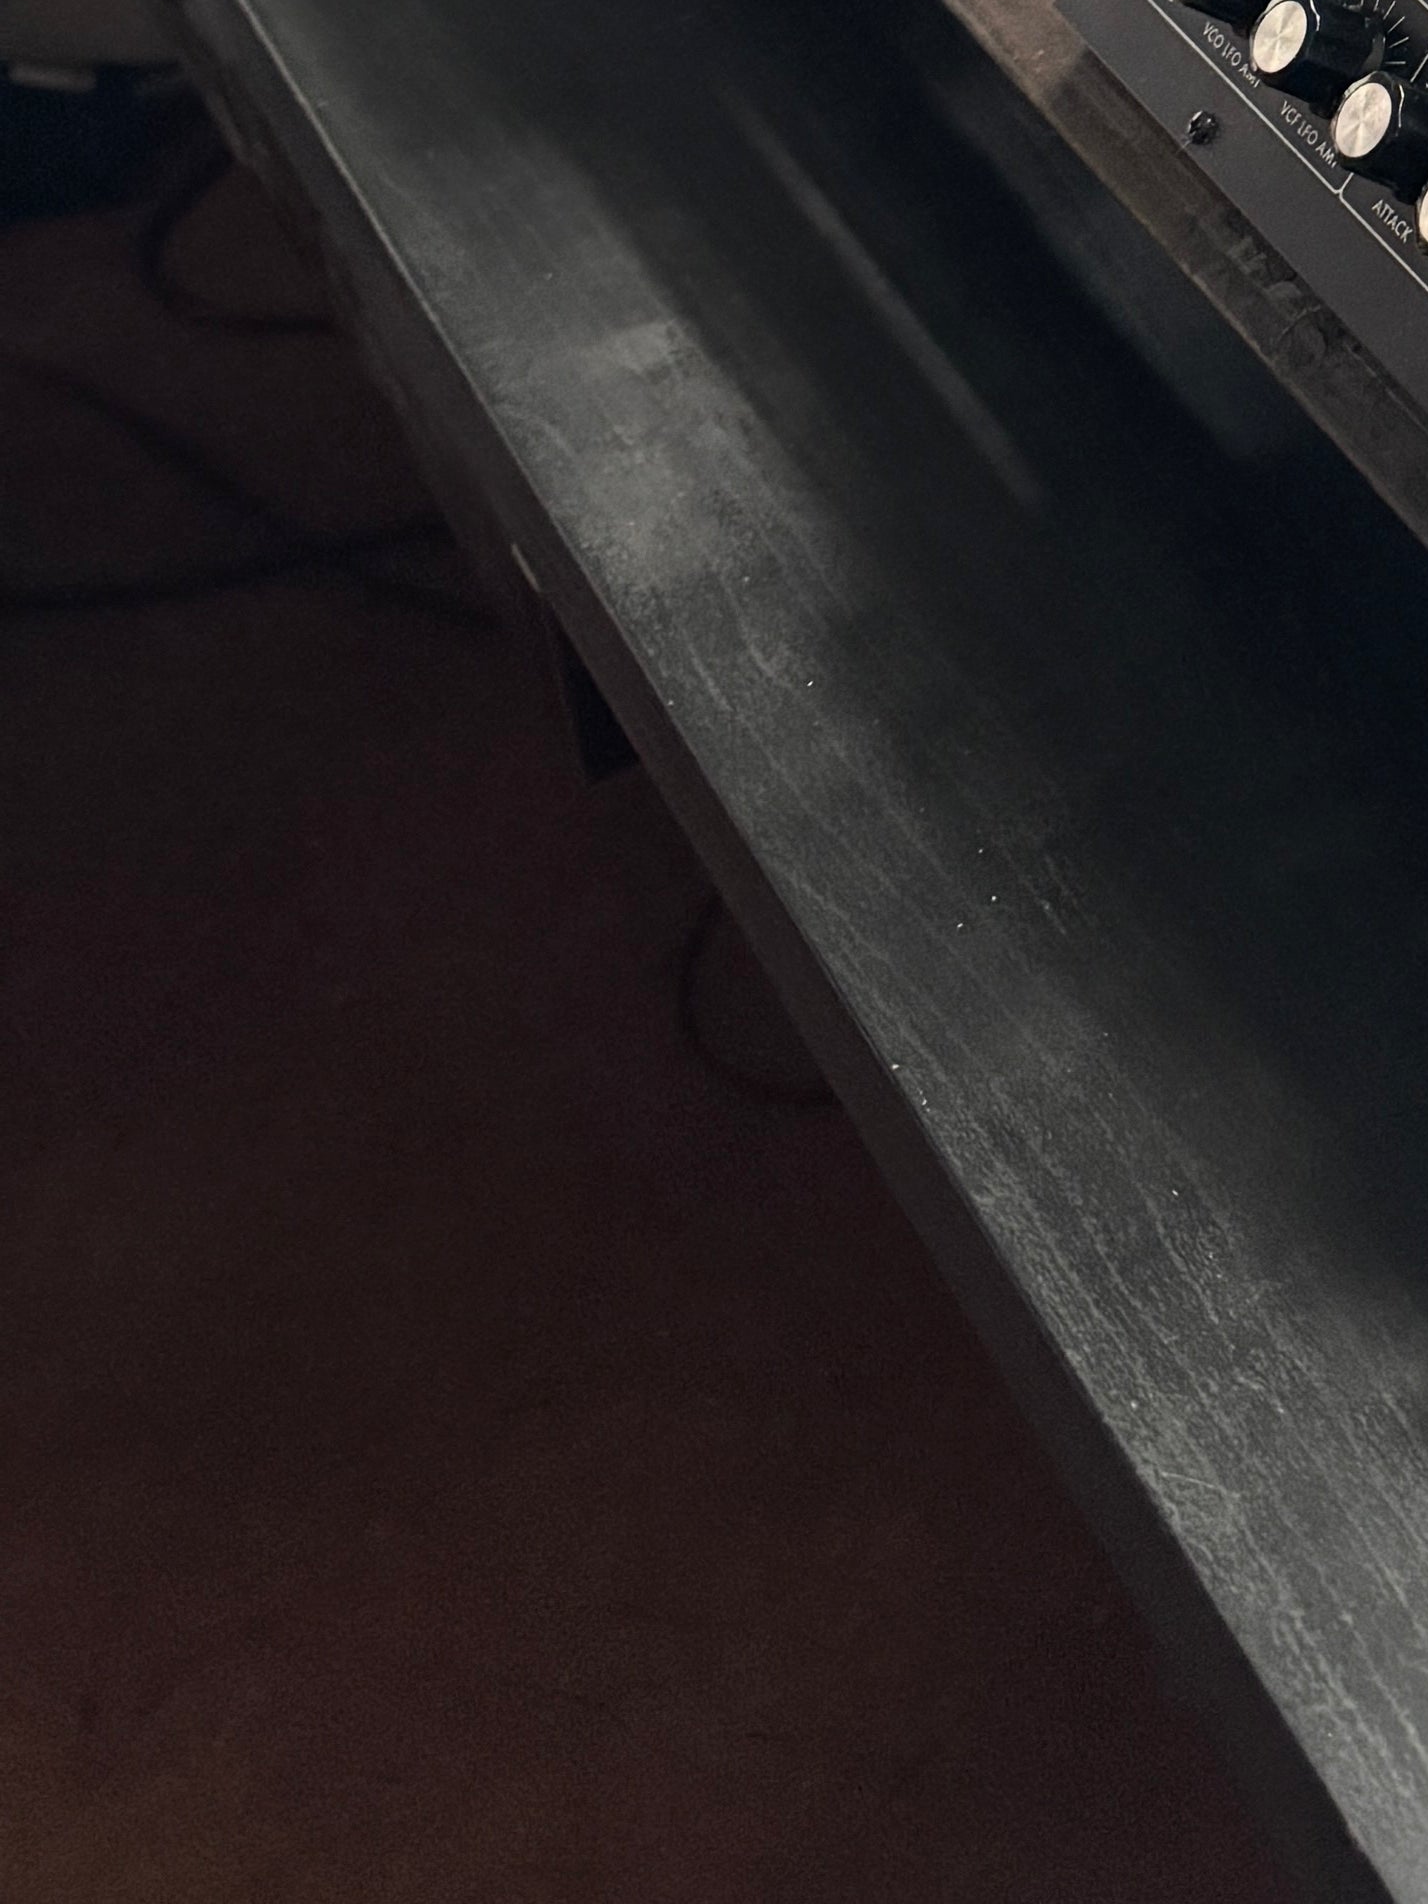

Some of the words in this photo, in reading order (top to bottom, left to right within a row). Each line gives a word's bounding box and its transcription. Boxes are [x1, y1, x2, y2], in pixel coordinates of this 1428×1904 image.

[1203, 21, 1225, 50] VCO
[1280, 100, 1300, 123] VCF
[1371, 199, 1413, 243] ATTACK
